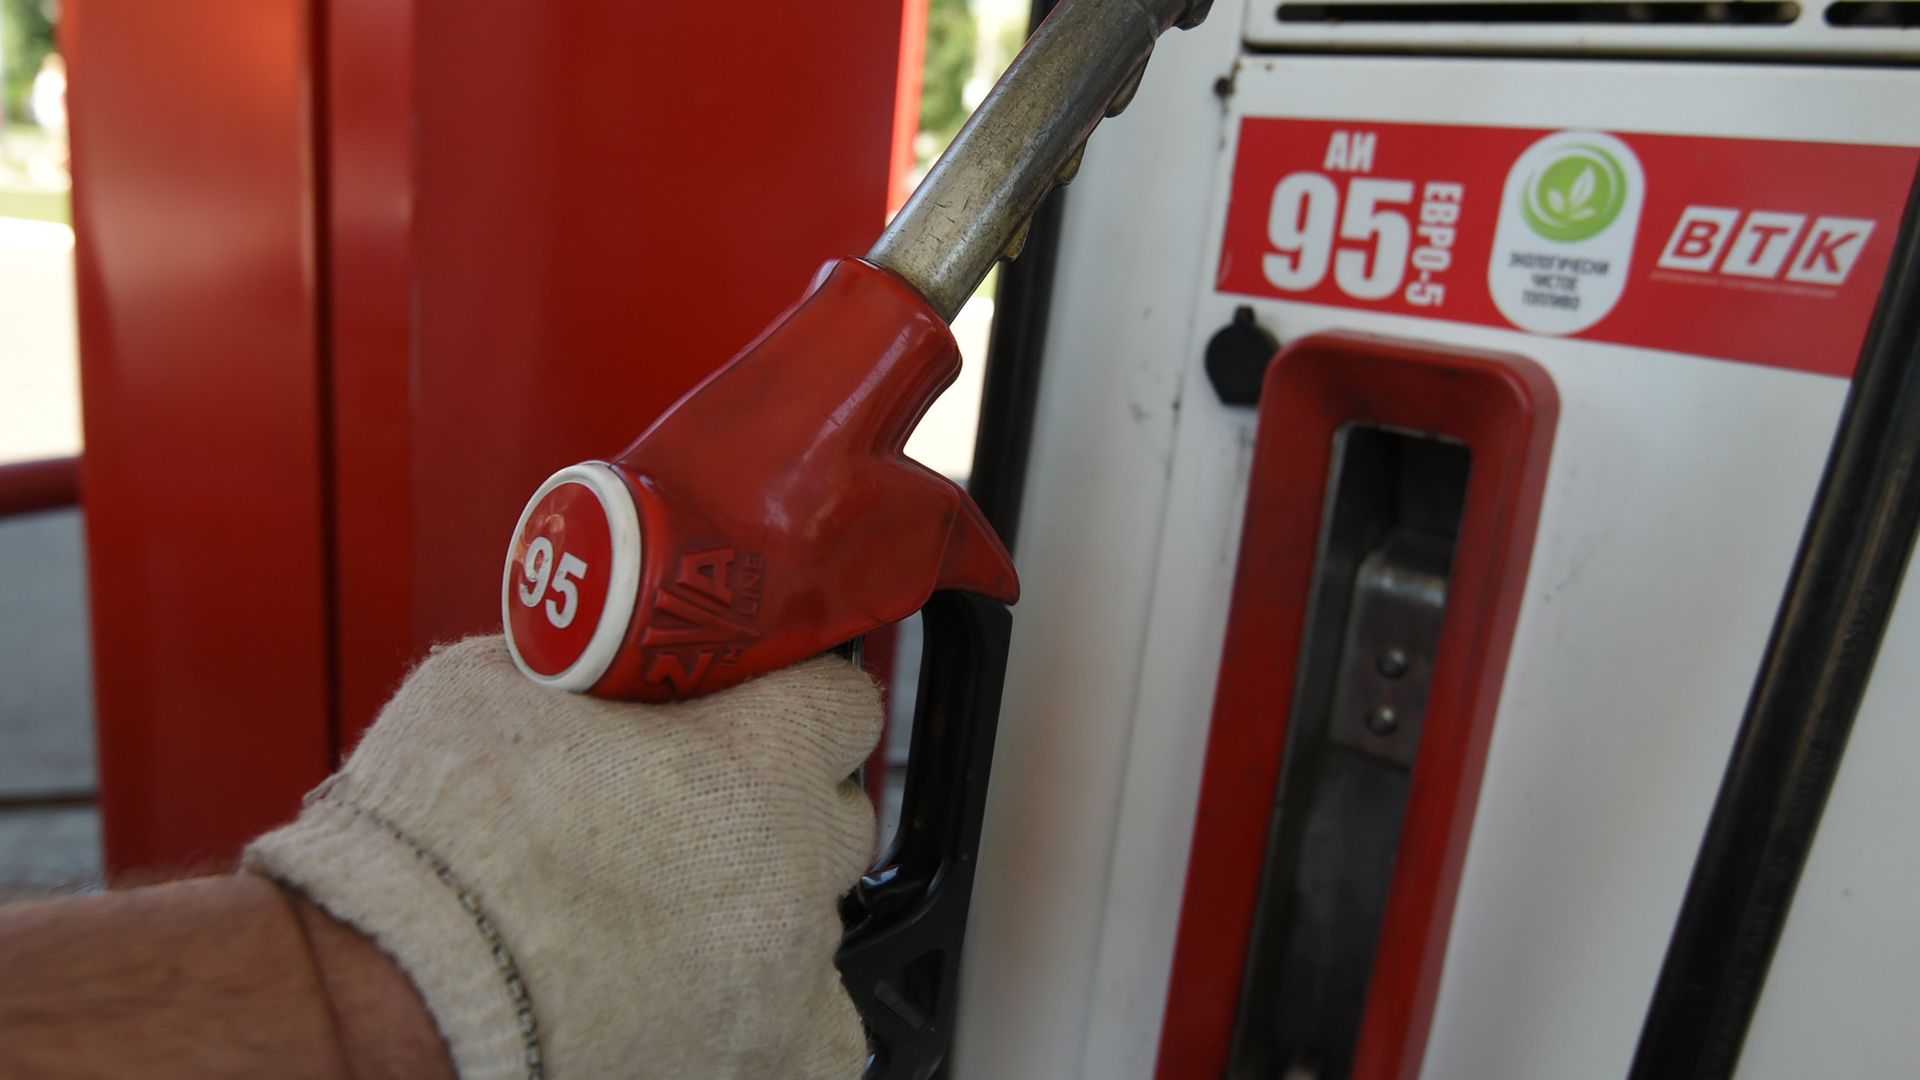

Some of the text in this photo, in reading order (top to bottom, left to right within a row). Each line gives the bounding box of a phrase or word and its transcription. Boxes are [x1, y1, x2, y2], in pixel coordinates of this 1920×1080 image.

[1323, 130, 1378, 172] АИ
[1261, 171, 1414, 300] 95
[1404, 181, 1464, 306] ЕВРО-5
[519, 536, 588, 629] 95
